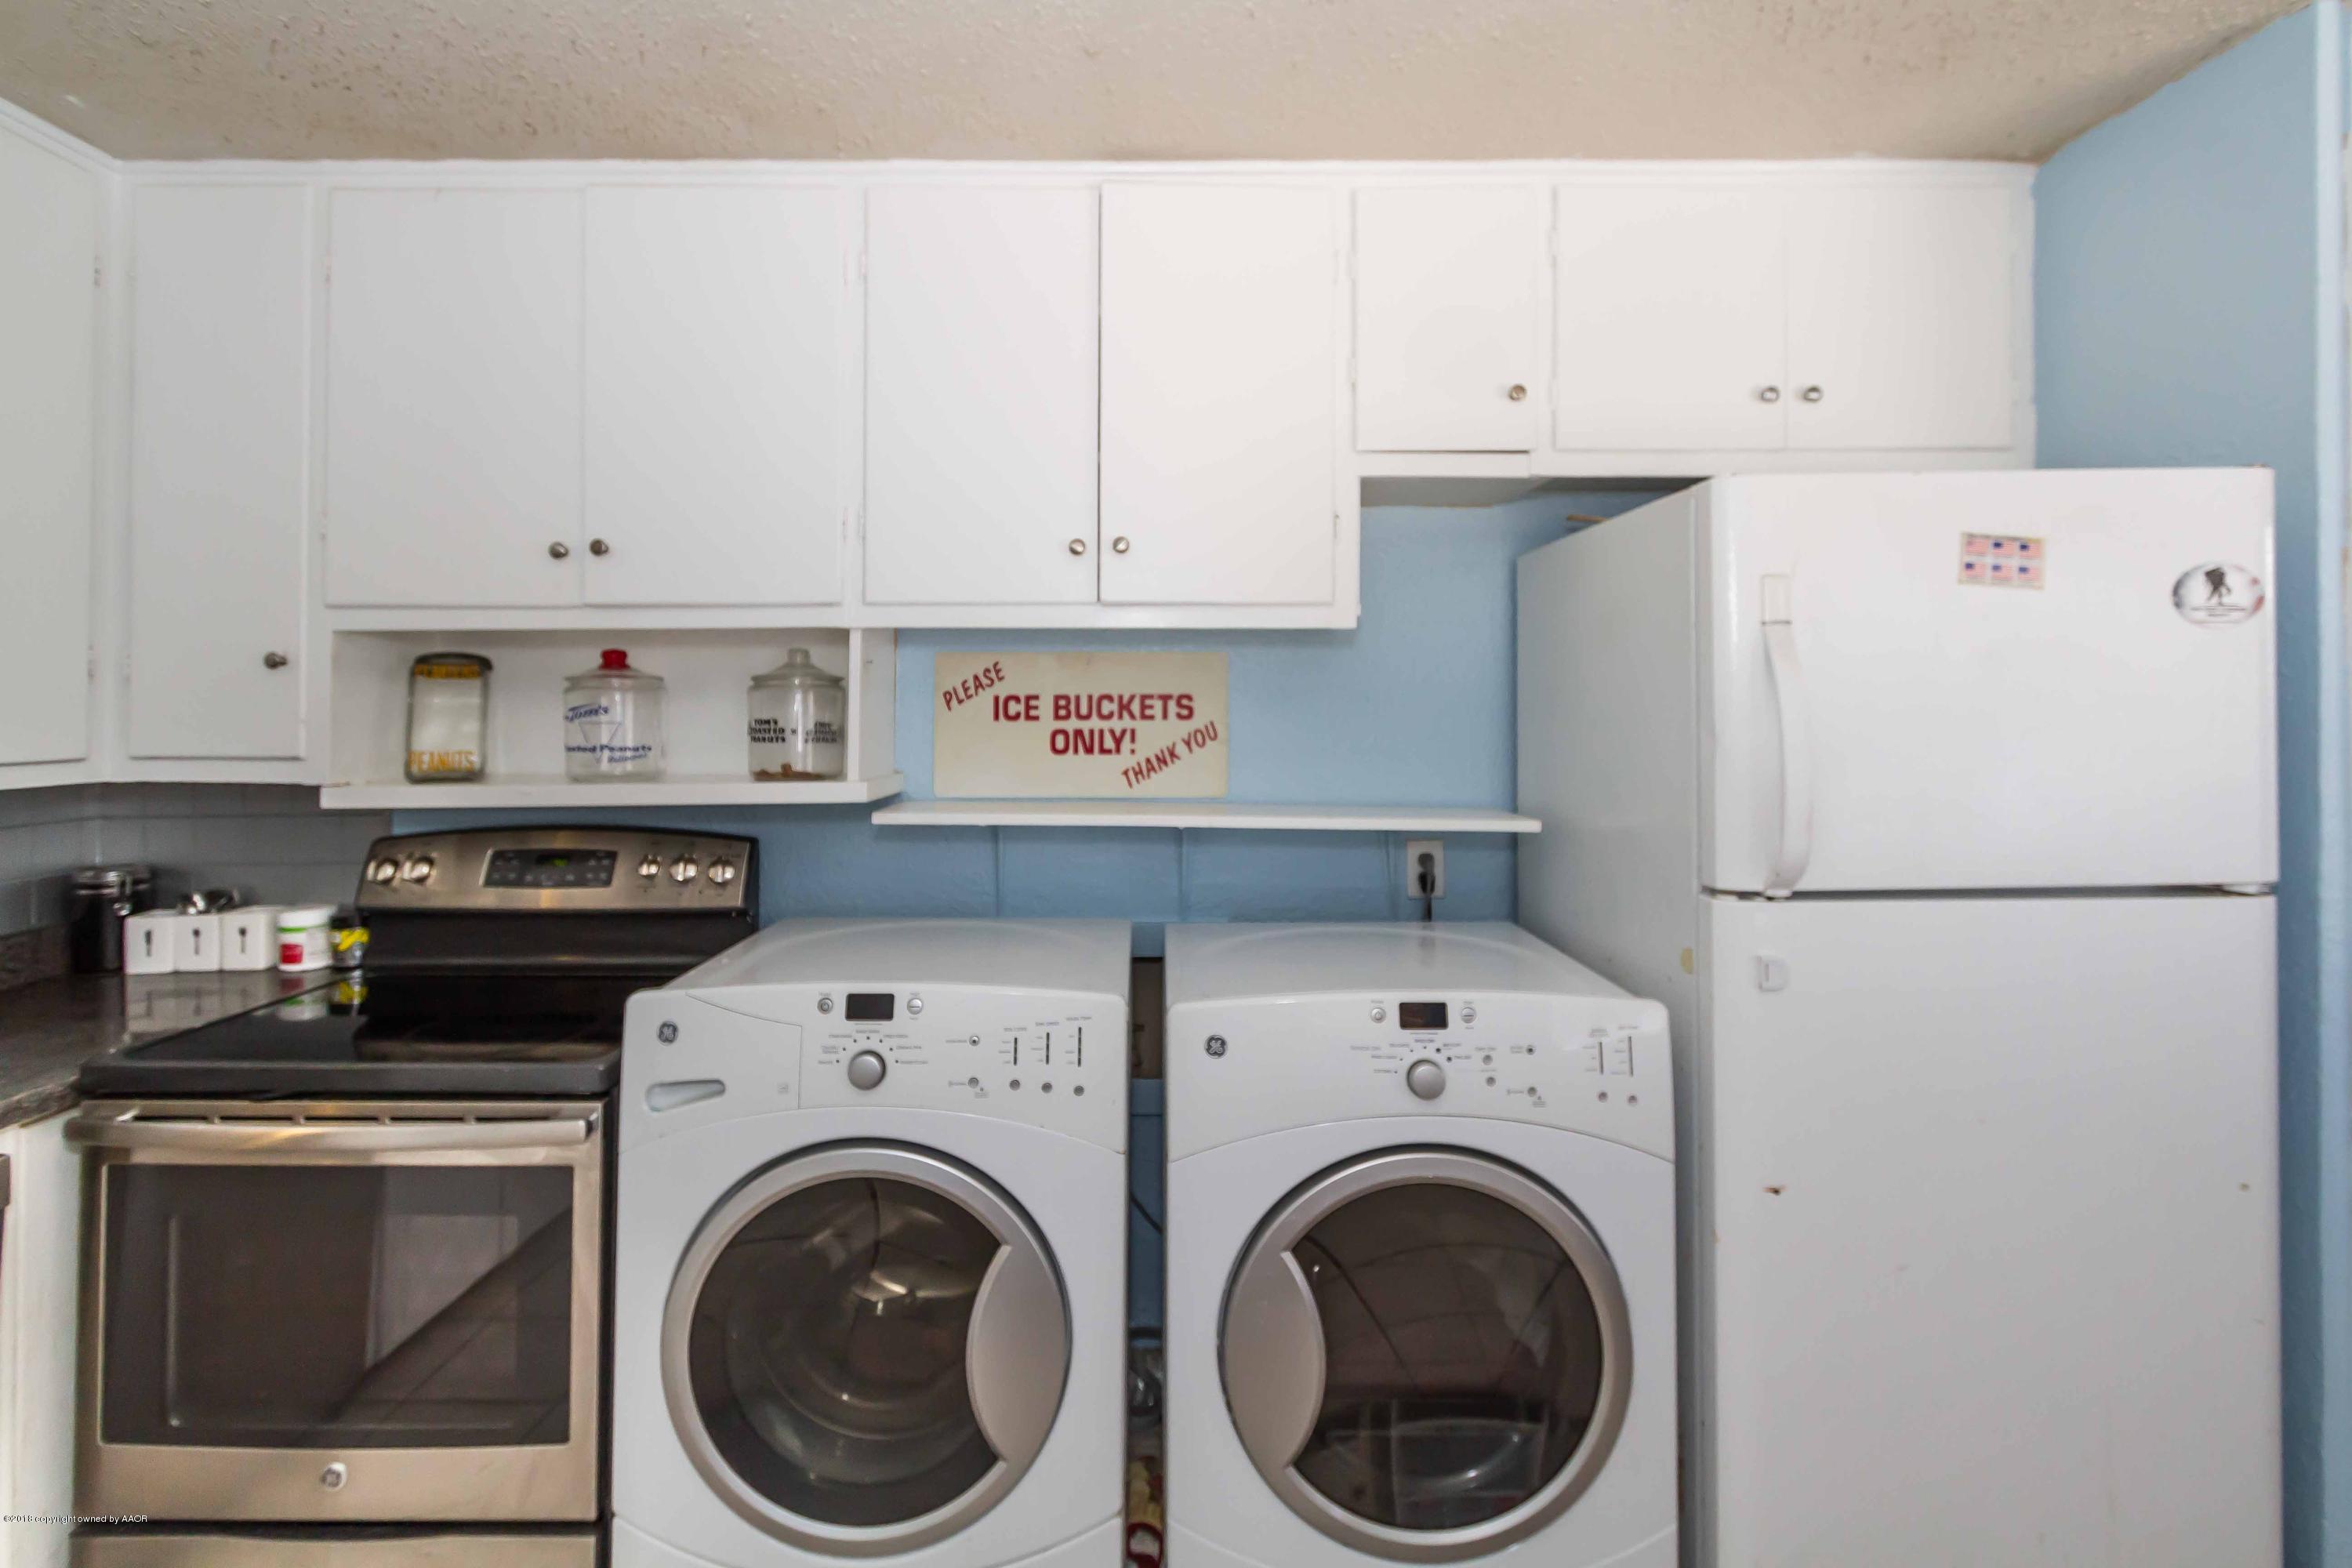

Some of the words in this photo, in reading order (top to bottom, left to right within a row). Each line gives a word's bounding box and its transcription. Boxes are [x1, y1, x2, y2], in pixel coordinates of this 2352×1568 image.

[942, 661, 1006, 712] PLEASE
[993, 695, 1040, 722] ICE
[1053, 694, 1195, 721] BUCKETS
[1049, 728, 1137, 756] ONLY!
[1121, 742, 1181, 789] THANK
[1181, 720, 1219, 756] YOU
